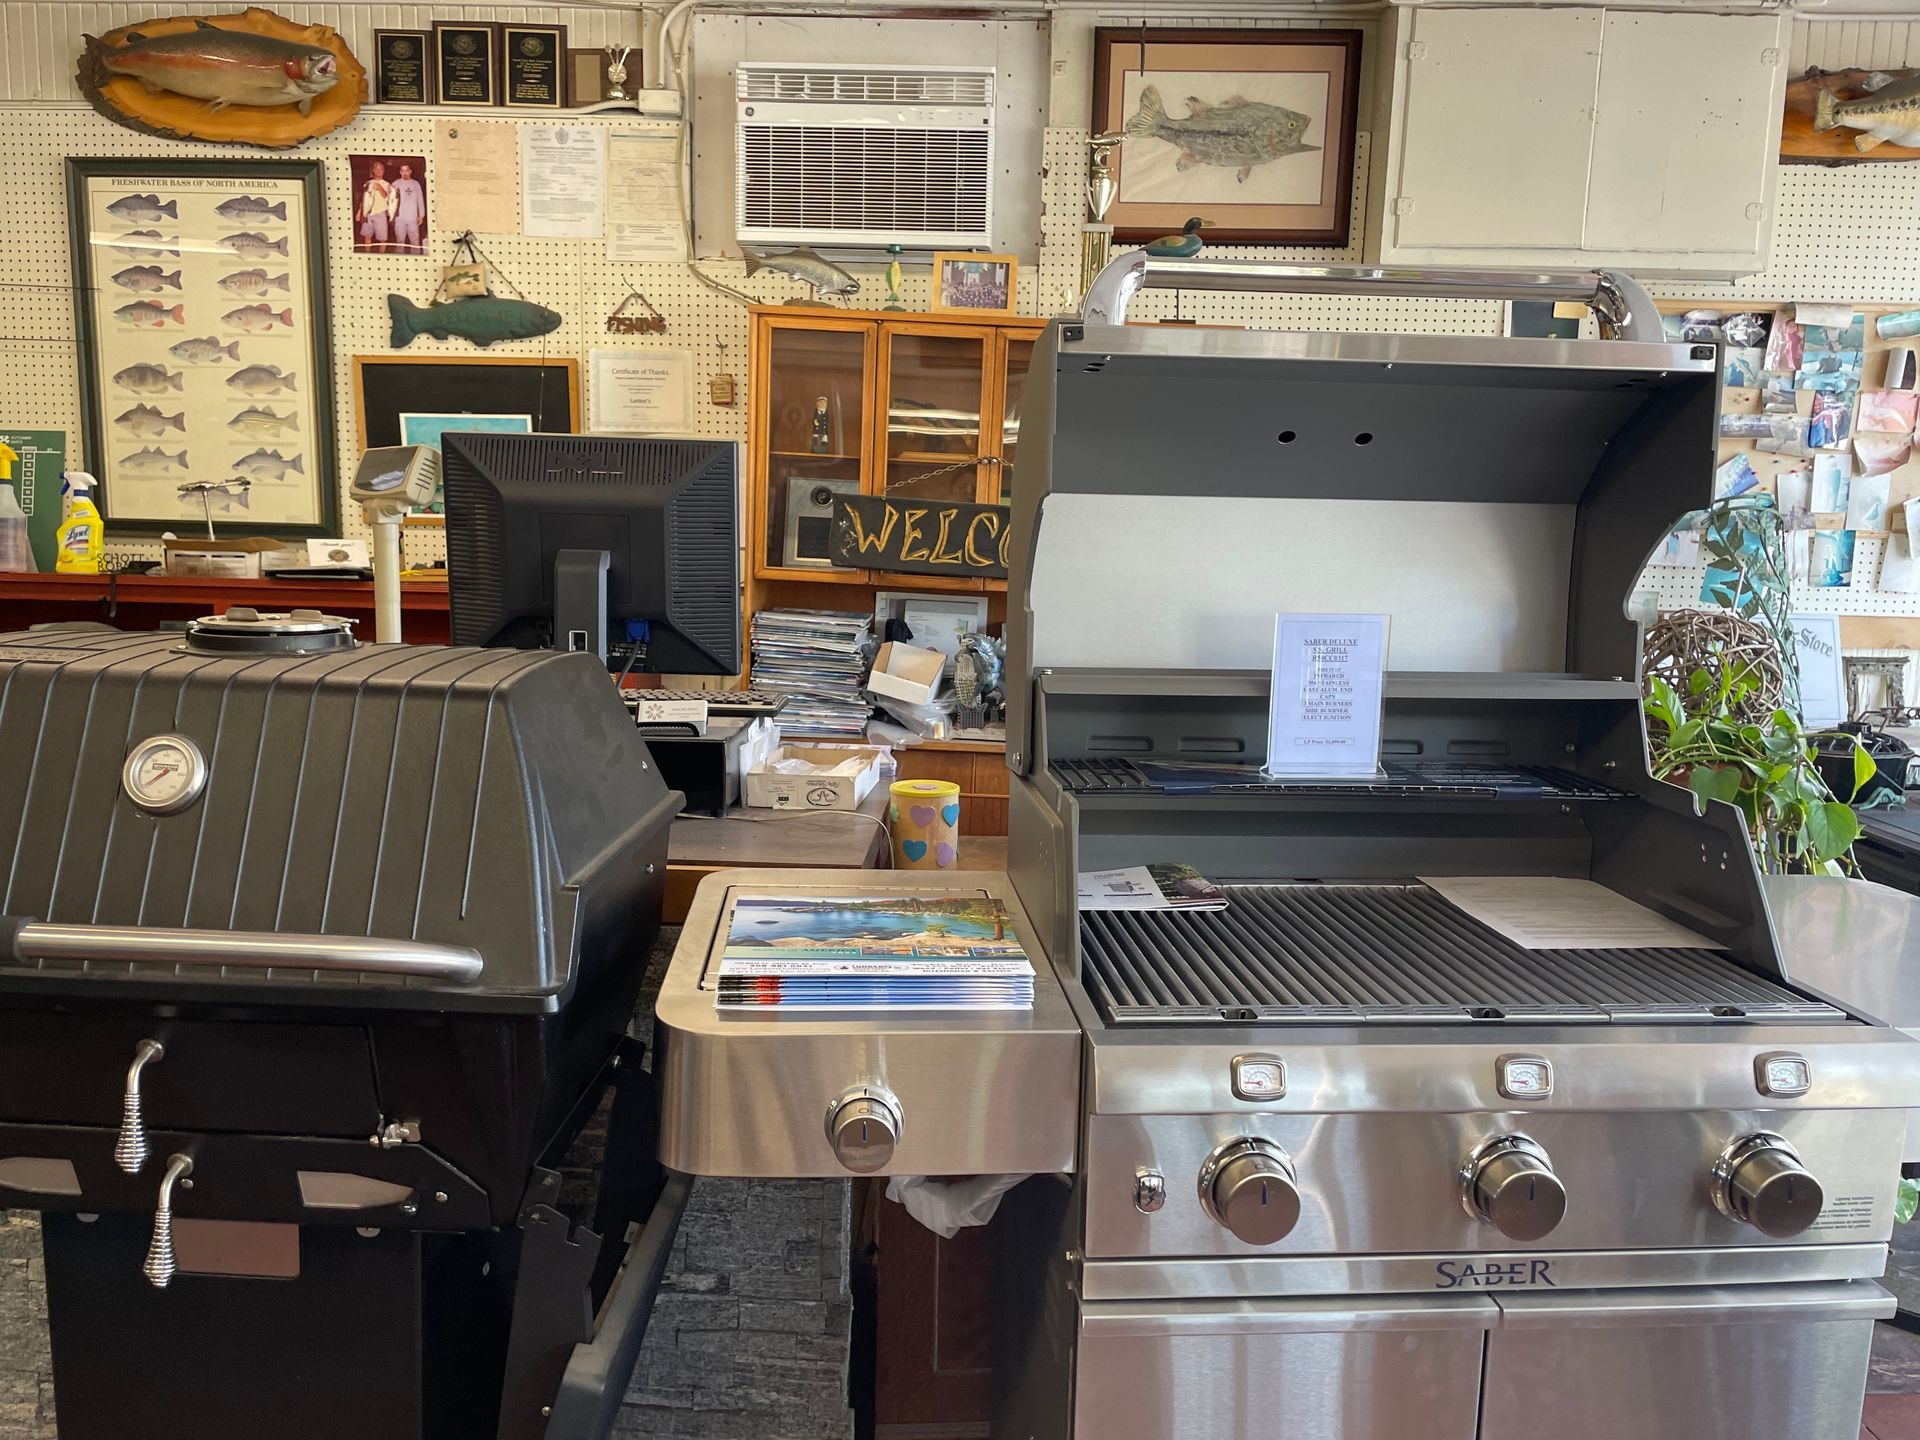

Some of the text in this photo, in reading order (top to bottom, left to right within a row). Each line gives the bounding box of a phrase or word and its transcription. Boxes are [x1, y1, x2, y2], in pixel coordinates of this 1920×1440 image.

[111, 178, 168, 187] FRESHWATER
[169, 179, 191, 187] BASS
[206, 180, 236, 188] NORTH
[238, 180, 279, 189] AMERICA
[606, 316, 667, 333] FISHING
[67, 526, 89, 541] Lysol
[97, 553, 145, 562] SCHOTT
[1304, 638, 1358, 647] SABER DELUXE
[1796, 627, 1833, 658] Store
[1435, 1259, 1557, 1290] SABER
